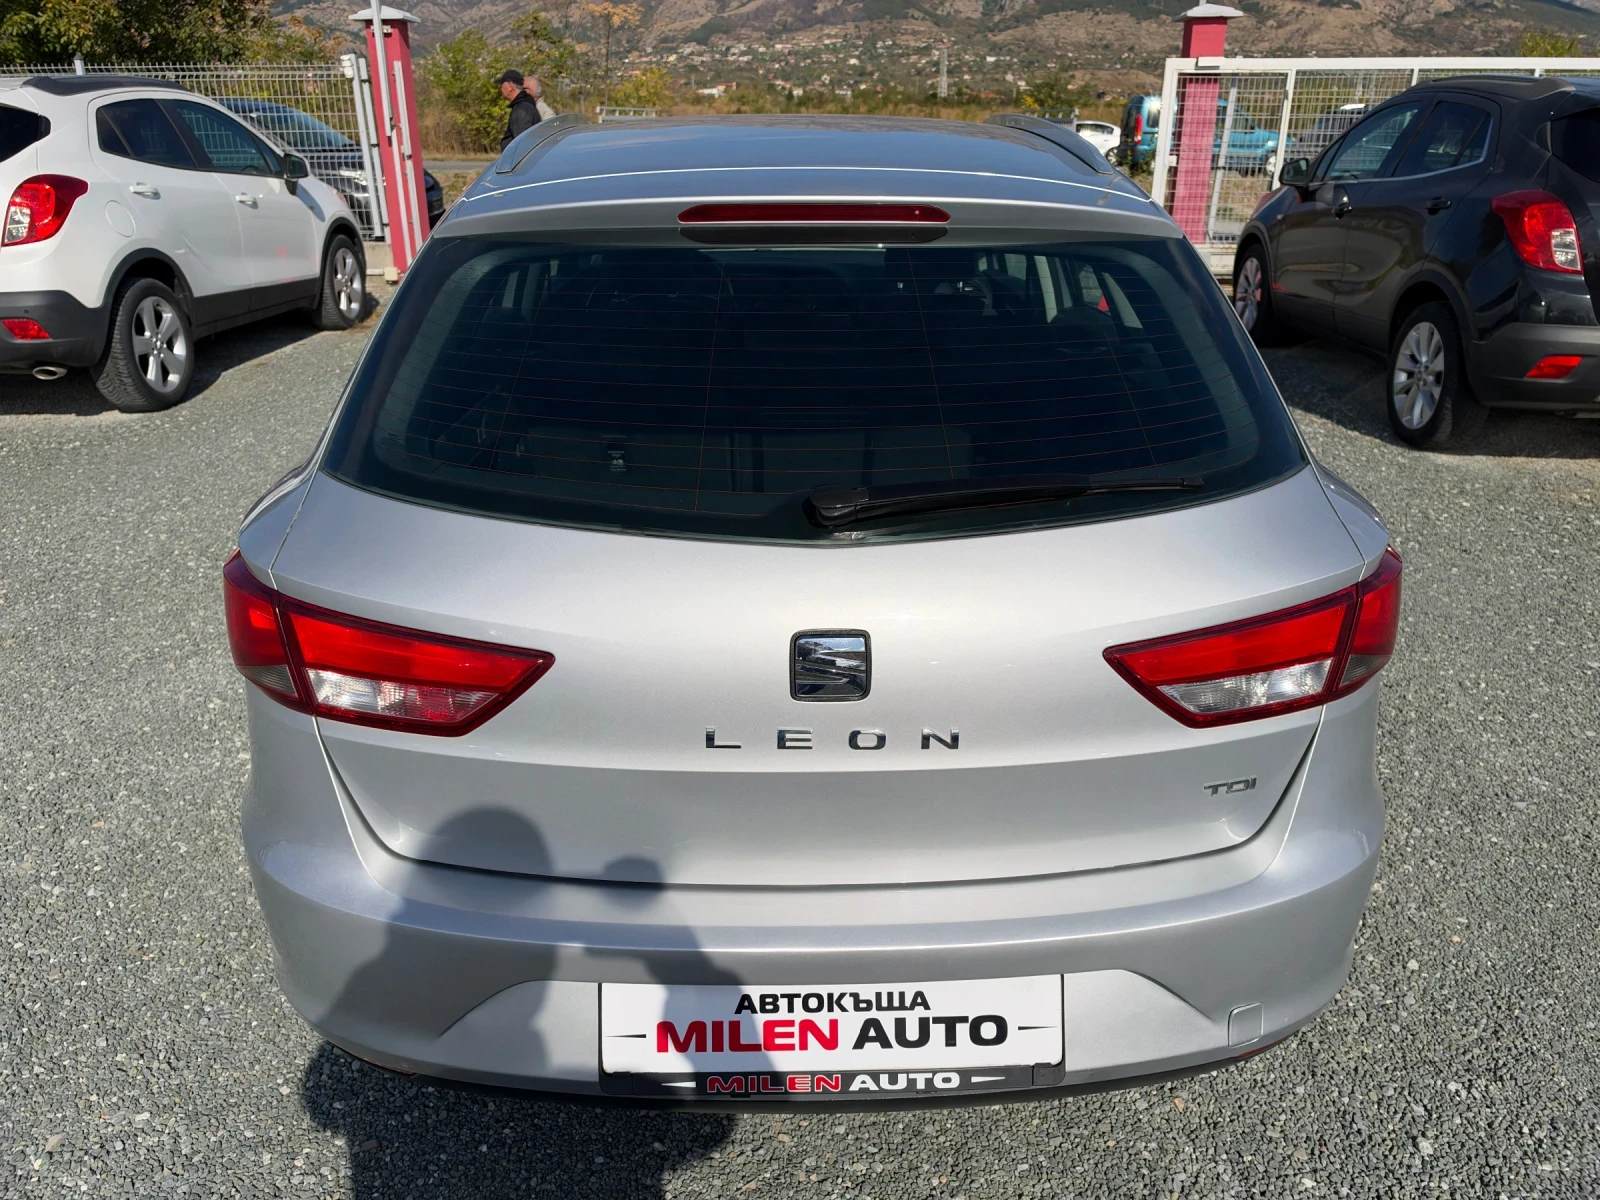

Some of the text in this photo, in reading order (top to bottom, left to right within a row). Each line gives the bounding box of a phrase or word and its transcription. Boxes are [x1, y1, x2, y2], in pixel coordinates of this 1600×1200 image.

[705, 726, 959, 750] LEON
[1203, 775, 1257, 796] TDI
[656, 1015, 1009, 1053] MILEN AUTO
[706, 1072, 960, 1093] MILEN AUTO
